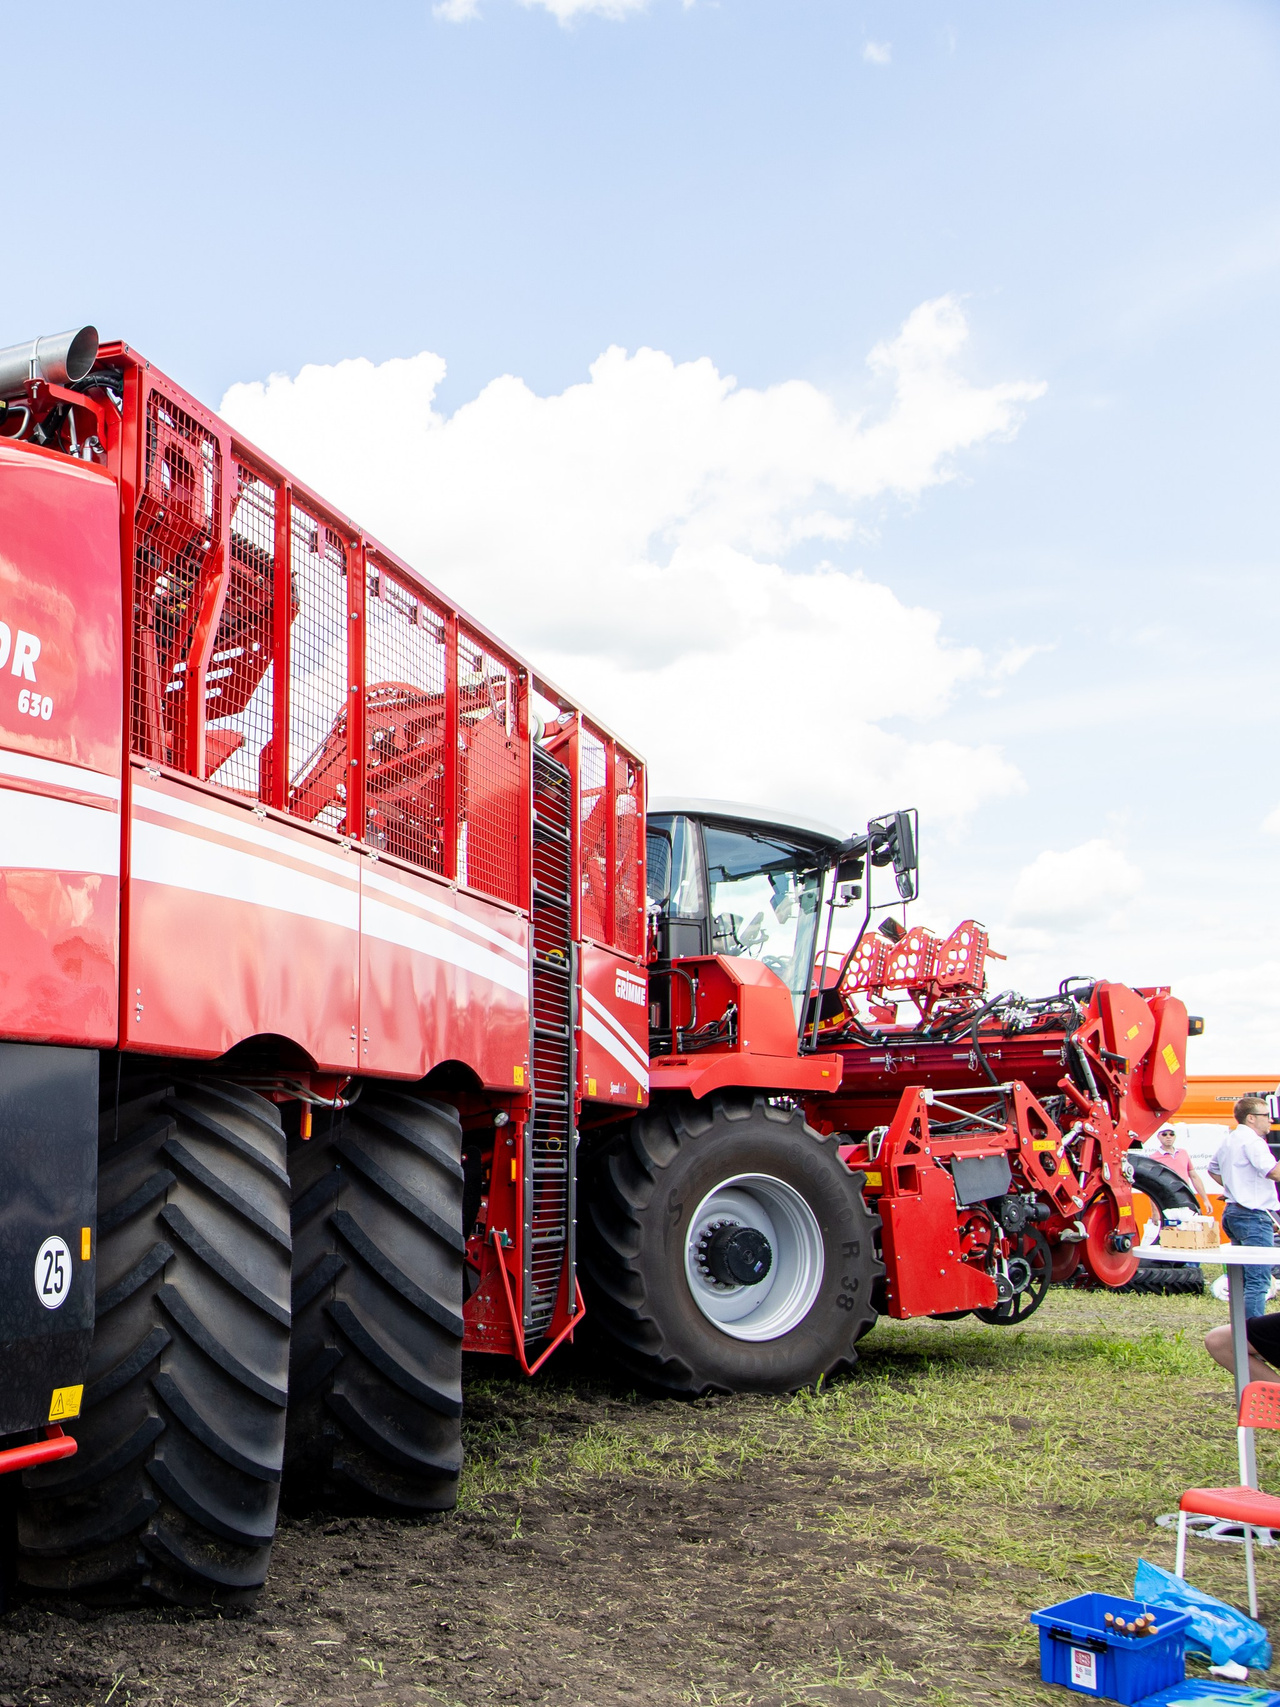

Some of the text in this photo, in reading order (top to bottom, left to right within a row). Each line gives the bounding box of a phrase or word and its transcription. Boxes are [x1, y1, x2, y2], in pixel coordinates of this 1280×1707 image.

[17, 688, 54, 721] 630
[615, 971, 646, 1006] GRIMME
[841, 1240, 860, 1259] R
[42, 1250, 65, 1295] 25
[835, 1275, 859, 1311] 38
